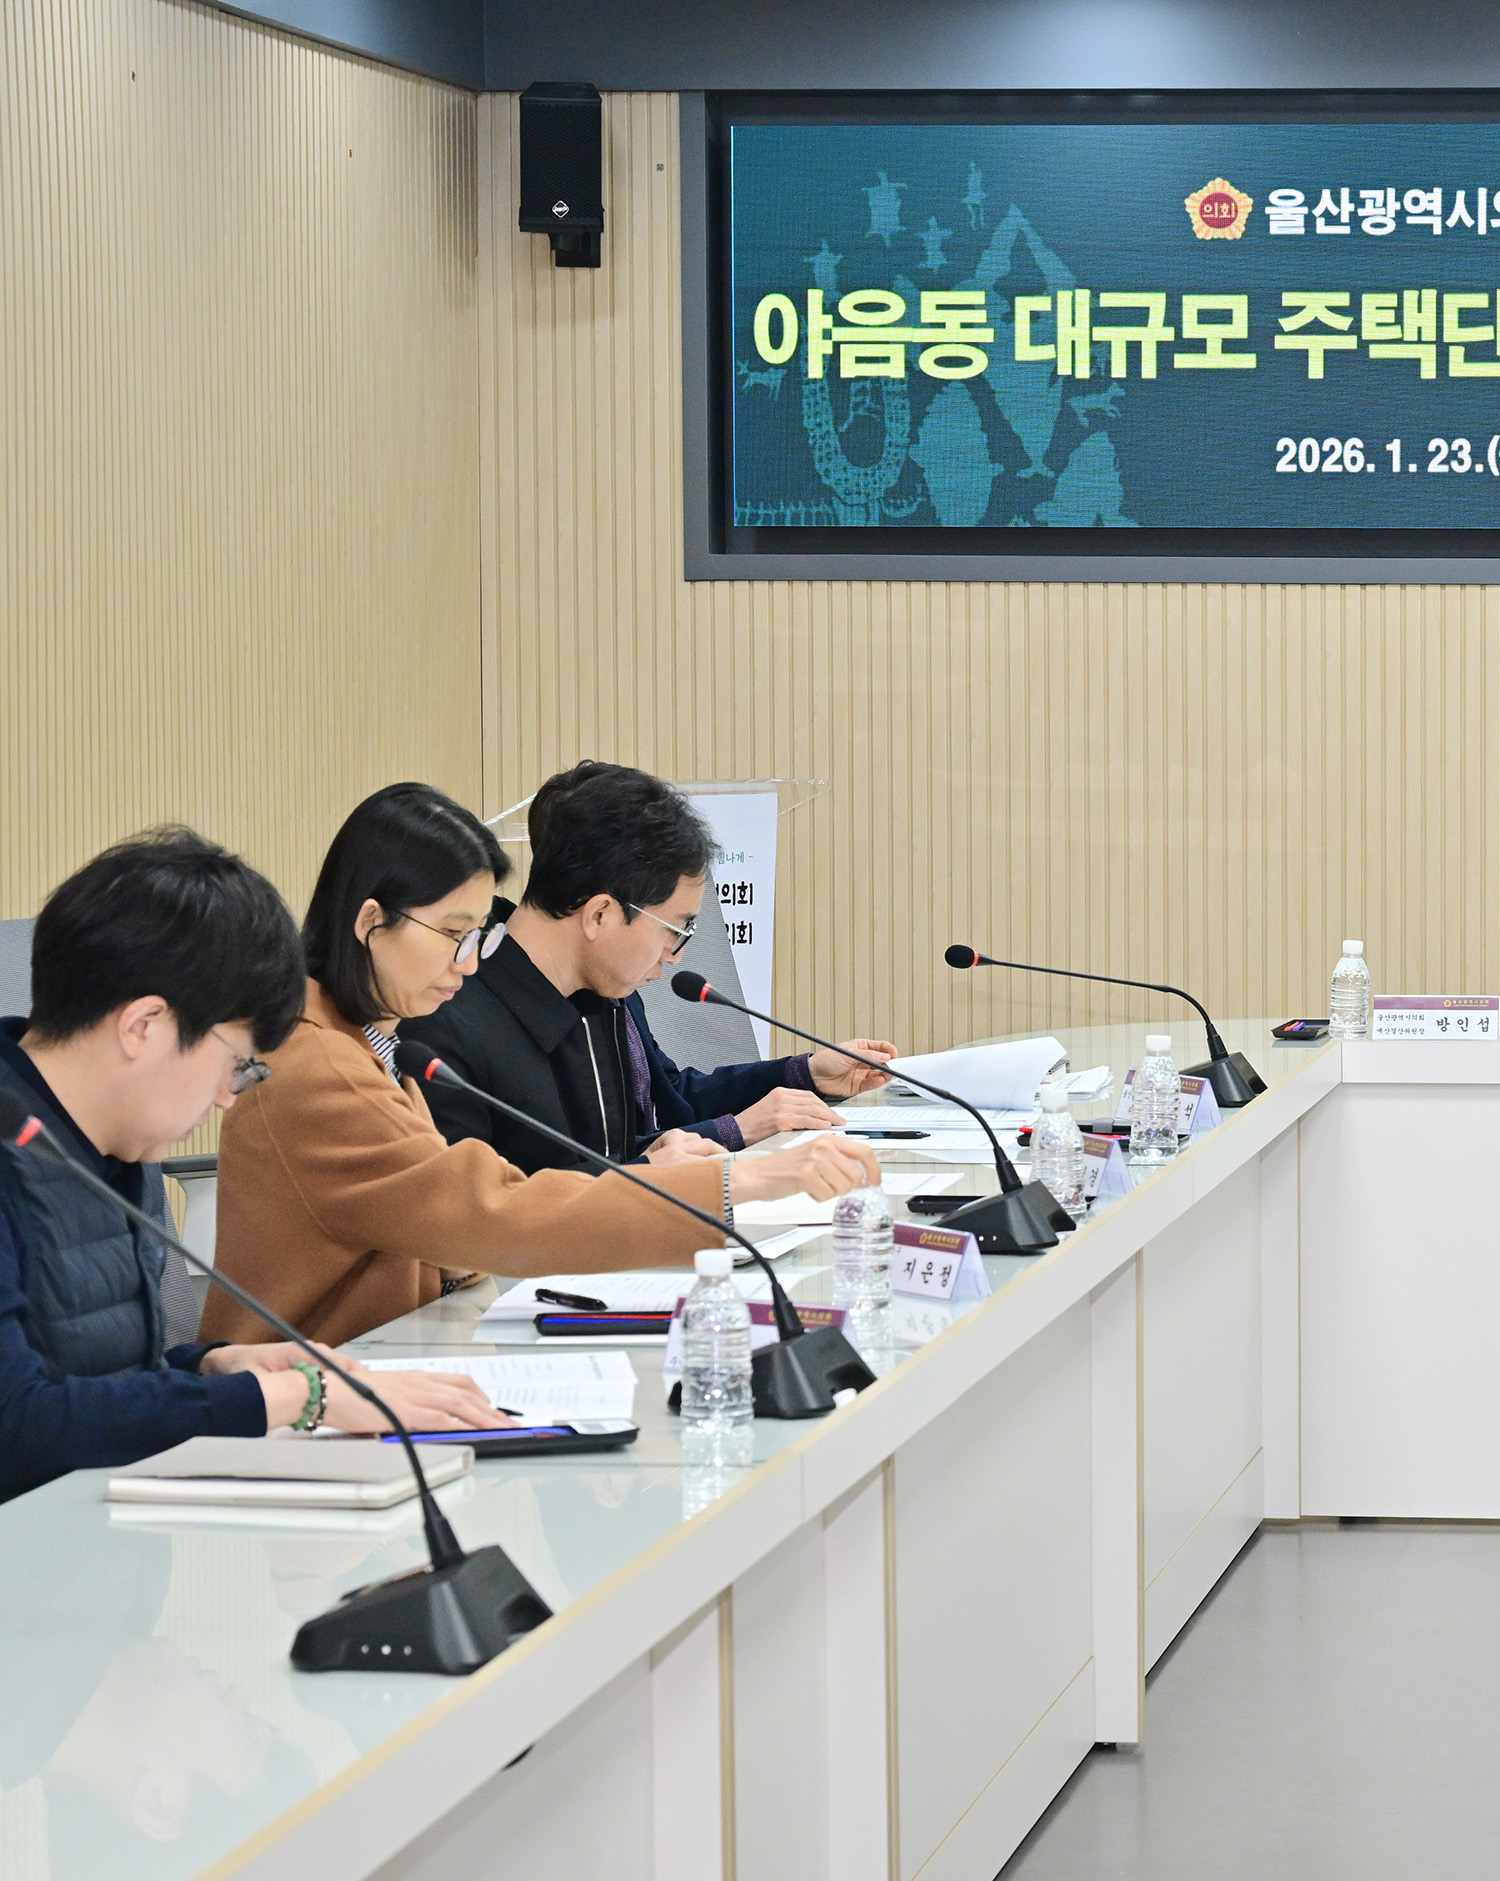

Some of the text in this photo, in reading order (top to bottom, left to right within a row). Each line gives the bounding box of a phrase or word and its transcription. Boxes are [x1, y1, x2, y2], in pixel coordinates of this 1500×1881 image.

[1202, 202, 1235, 218] 의회
[753, 289, 995, 381] 야음동
[1014, 289, 1258, 380] 대규모
[1275, 437, 1376, 475] 2026.
[1386, 439, 1418, 475] 1.
[715, 881, 753, 906] 의회
[903, 1258, 952, 1288] 지은정
